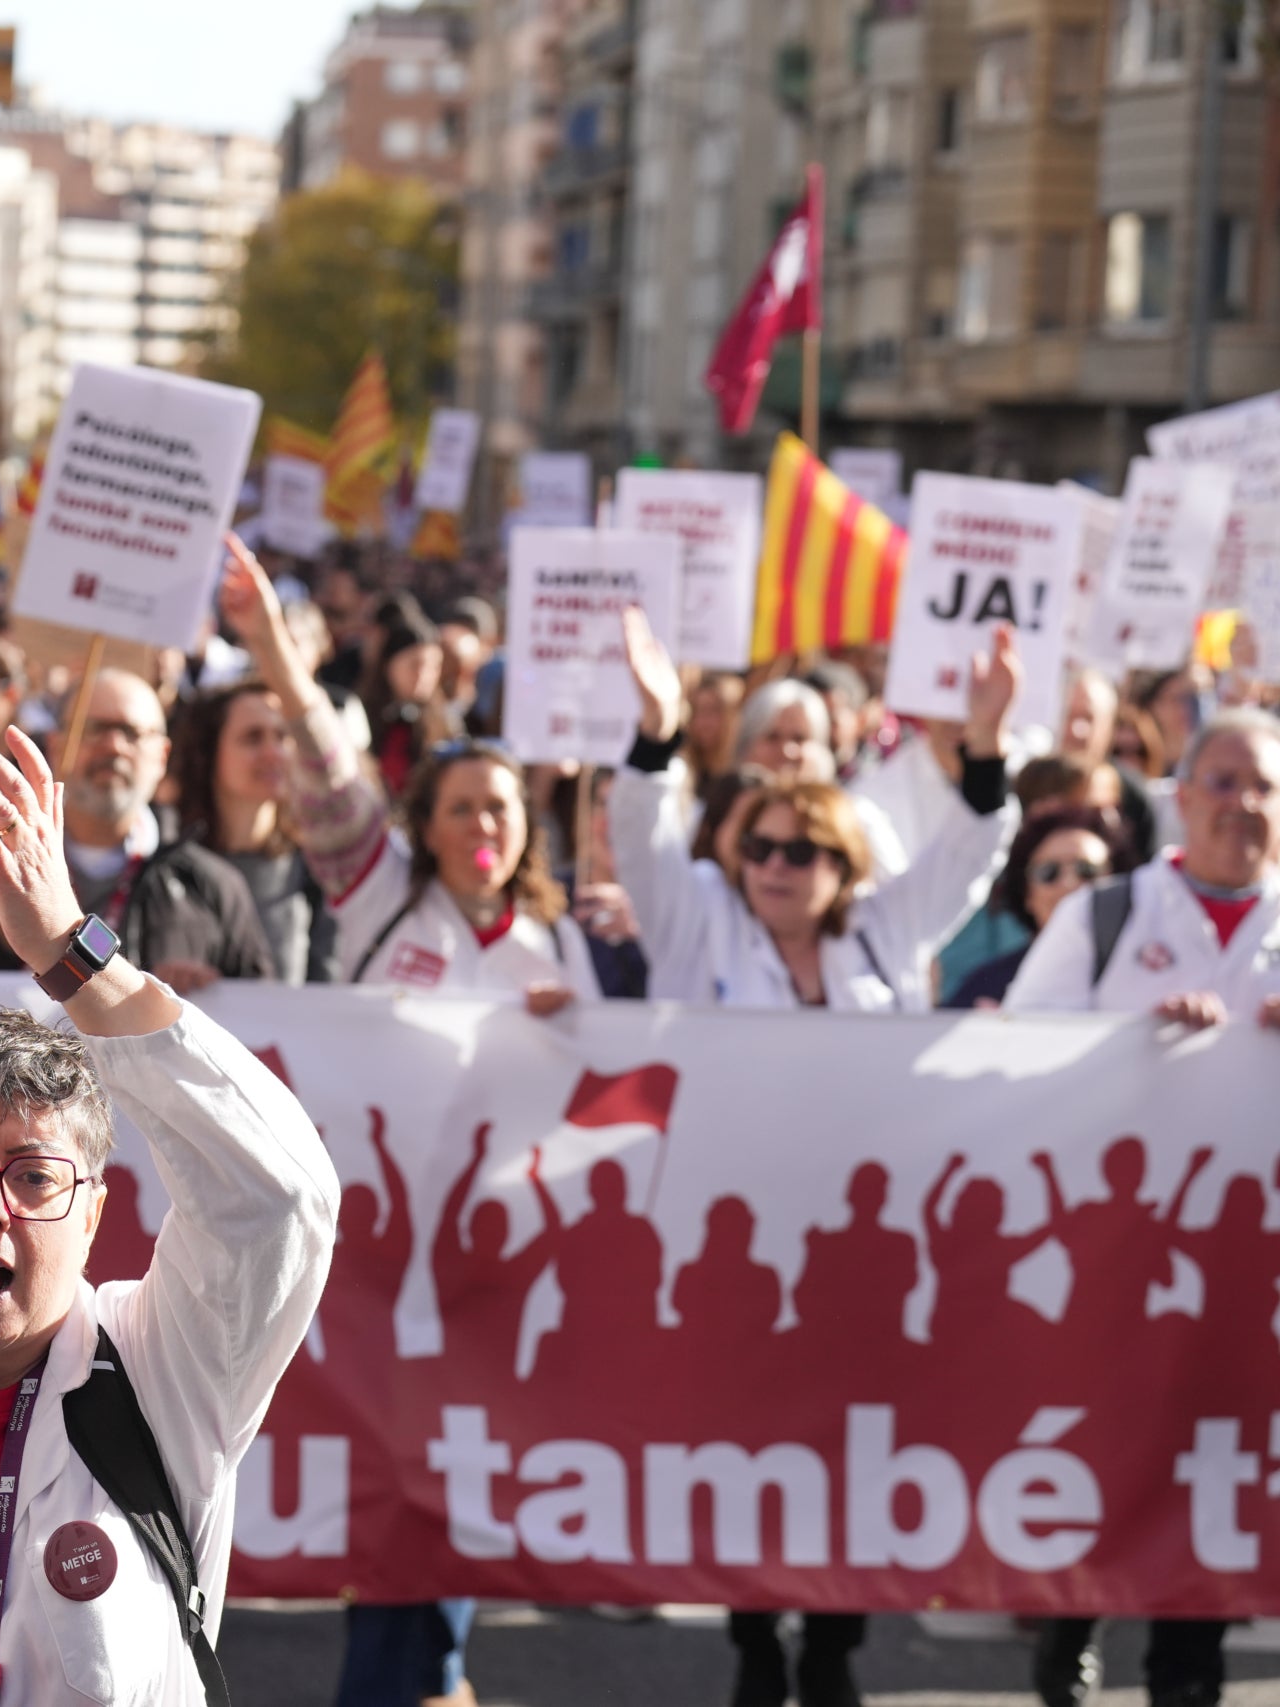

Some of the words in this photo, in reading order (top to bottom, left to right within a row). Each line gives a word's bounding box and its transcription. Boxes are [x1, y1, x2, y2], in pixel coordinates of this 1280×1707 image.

[928, 571, 1047, 631] JA!
[428, 1404, 1104, 1573] també
[61, 1548, 102, 1572] METGE
